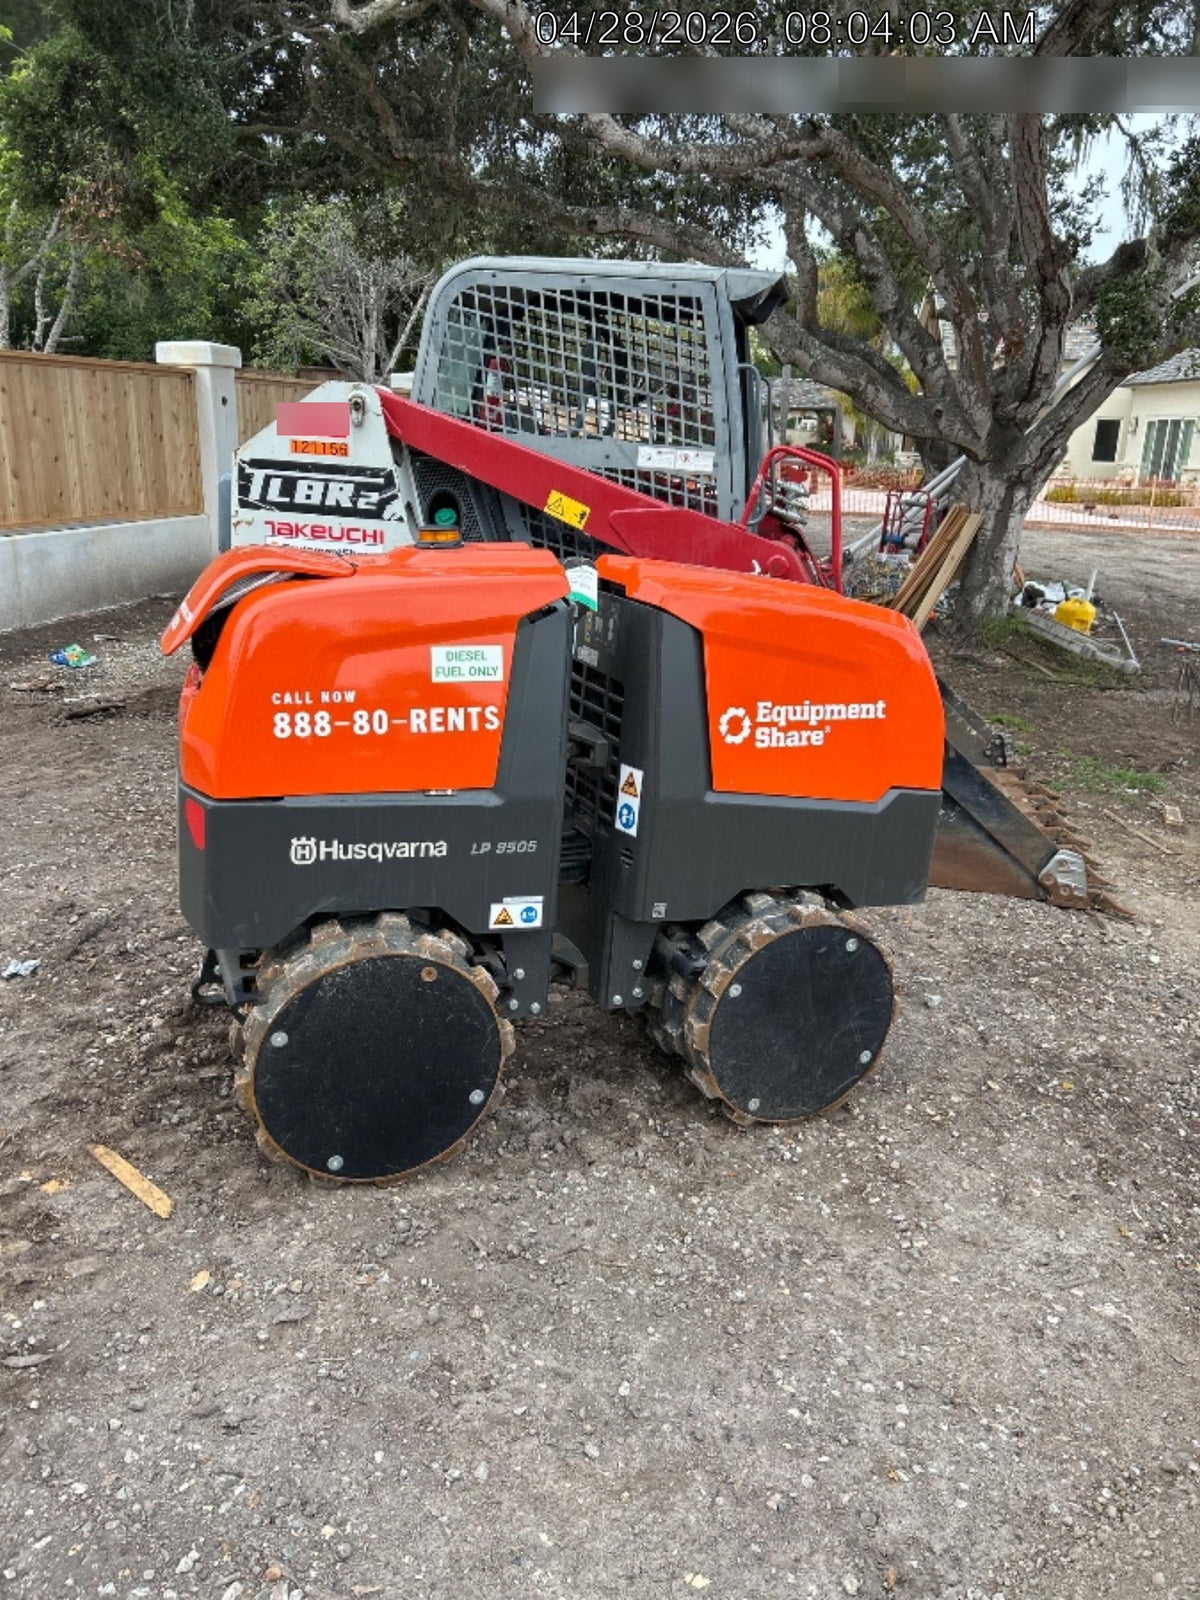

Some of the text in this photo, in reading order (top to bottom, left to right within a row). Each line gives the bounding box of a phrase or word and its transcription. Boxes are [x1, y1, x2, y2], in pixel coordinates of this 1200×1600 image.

[446, 650, 487, 662] DIESEL
[435, 665, 499, 678] FUEL ONLY
[271, 690, 356, 705] CALL NOW
[755, 700, 887, 727] Equipment
[272, 705, 500, 739] 888-80-RENTS
[319, 838, 448, 863] Husqvarna
[470, 842, 492, 855] LP
